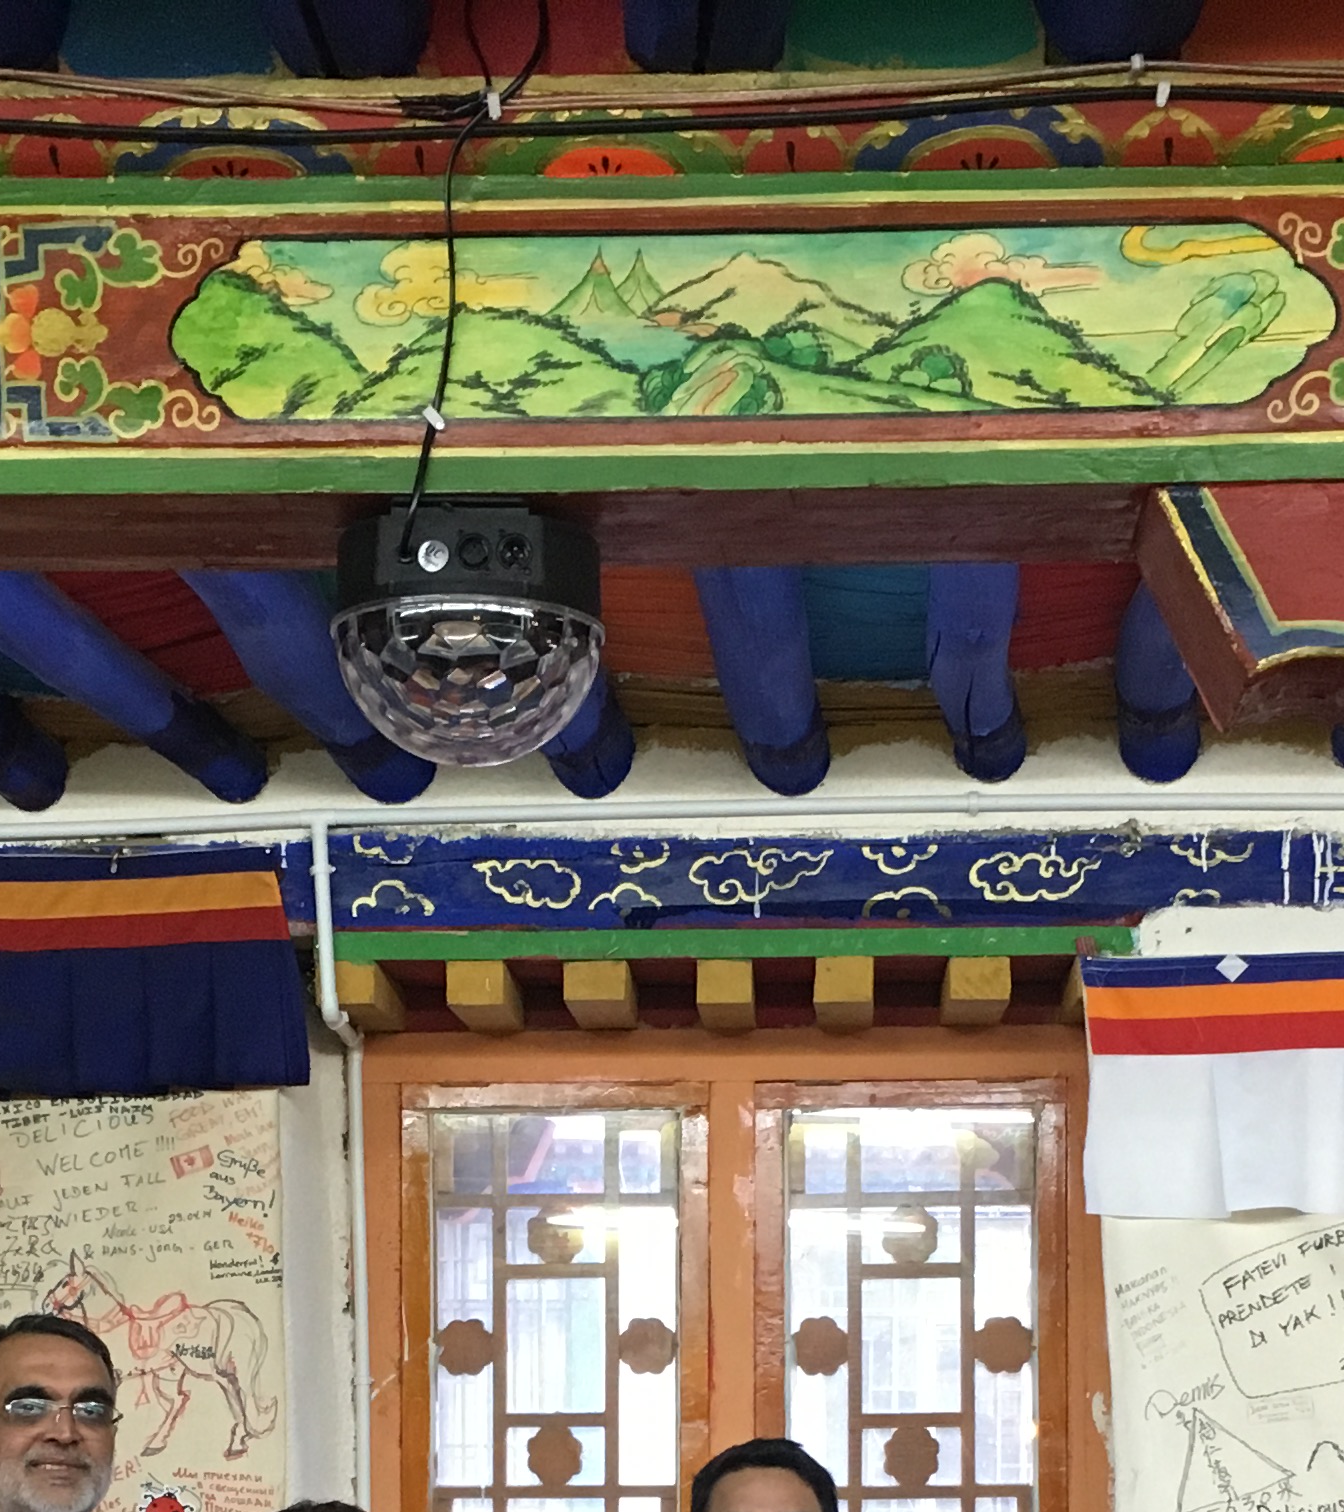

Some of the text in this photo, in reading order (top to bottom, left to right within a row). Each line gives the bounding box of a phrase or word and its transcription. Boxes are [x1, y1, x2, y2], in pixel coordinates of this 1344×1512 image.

[37, 1140, 149, 1176] WELCOME
[1222, 1253, 1286, 1298] FATEVI
[1218, 1274, 1311, 1329] PRENDETE
